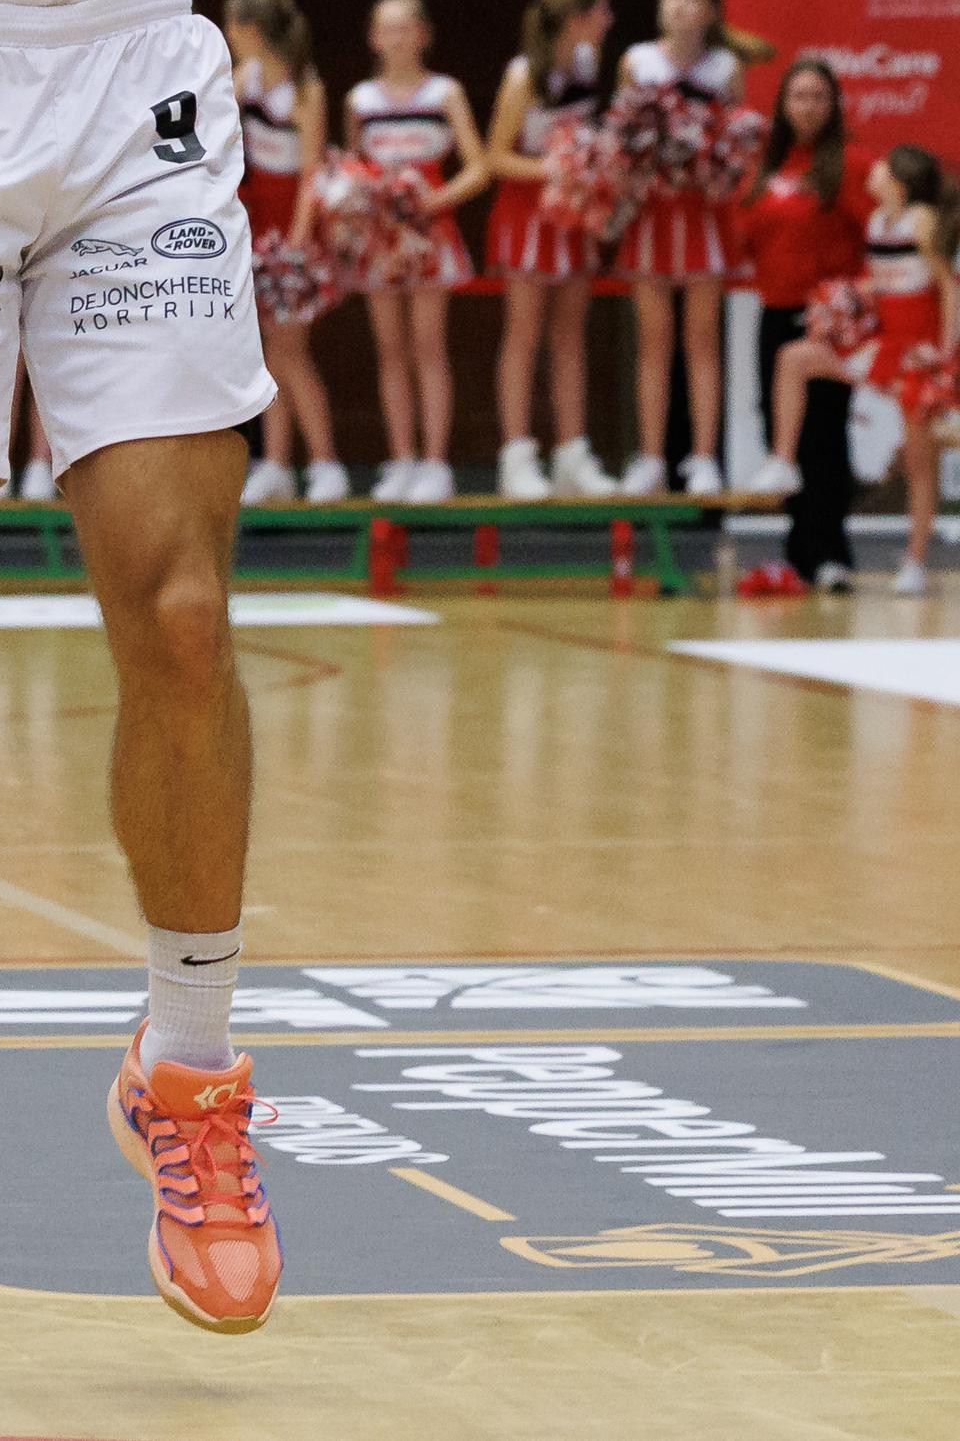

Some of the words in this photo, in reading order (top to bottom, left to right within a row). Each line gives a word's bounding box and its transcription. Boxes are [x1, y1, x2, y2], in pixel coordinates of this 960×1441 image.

[150, 90, 206, 164] 9
[69, 258, 148, 280] JAGUAR
[70, 276, 235, 314] DEJONCKHEERE
[73, 299, 235, 336] KORTRIJK
